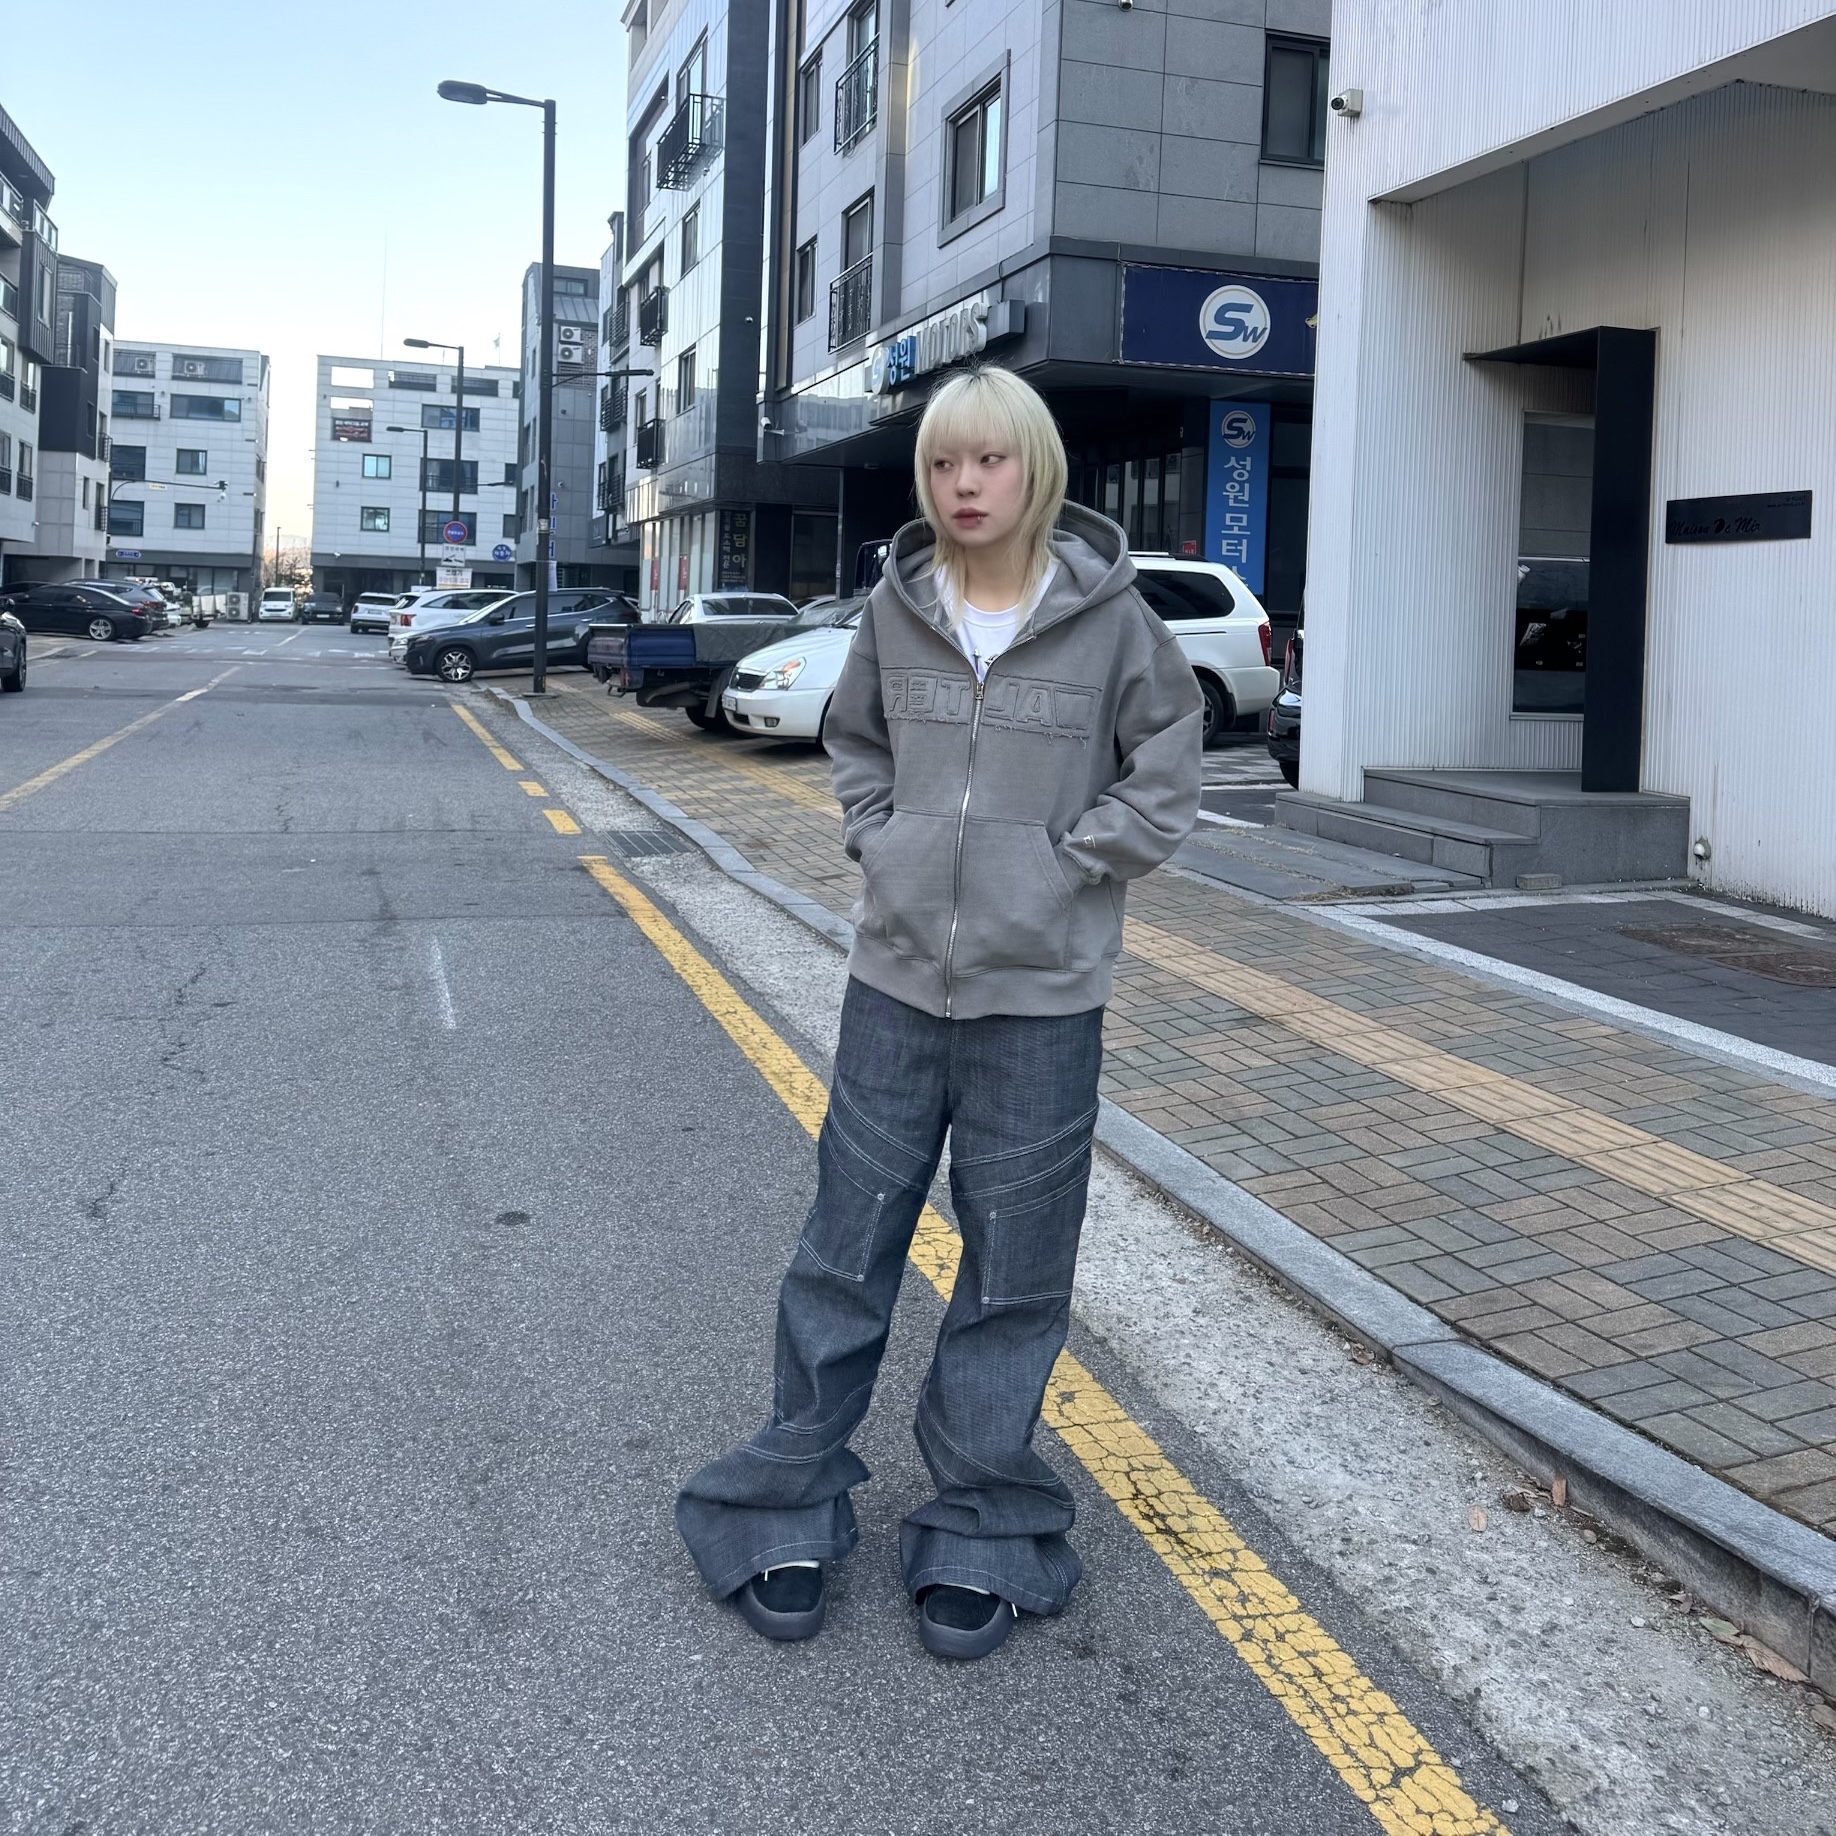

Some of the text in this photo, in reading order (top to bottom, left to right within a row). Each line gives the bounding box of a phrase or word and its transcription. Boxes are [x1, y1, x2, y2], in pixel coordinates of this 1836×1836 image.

[887, 338, 915, 386] 성원
[915, 302, 987, 375] MOTORS
[1713, 517, 1731, 534] De
